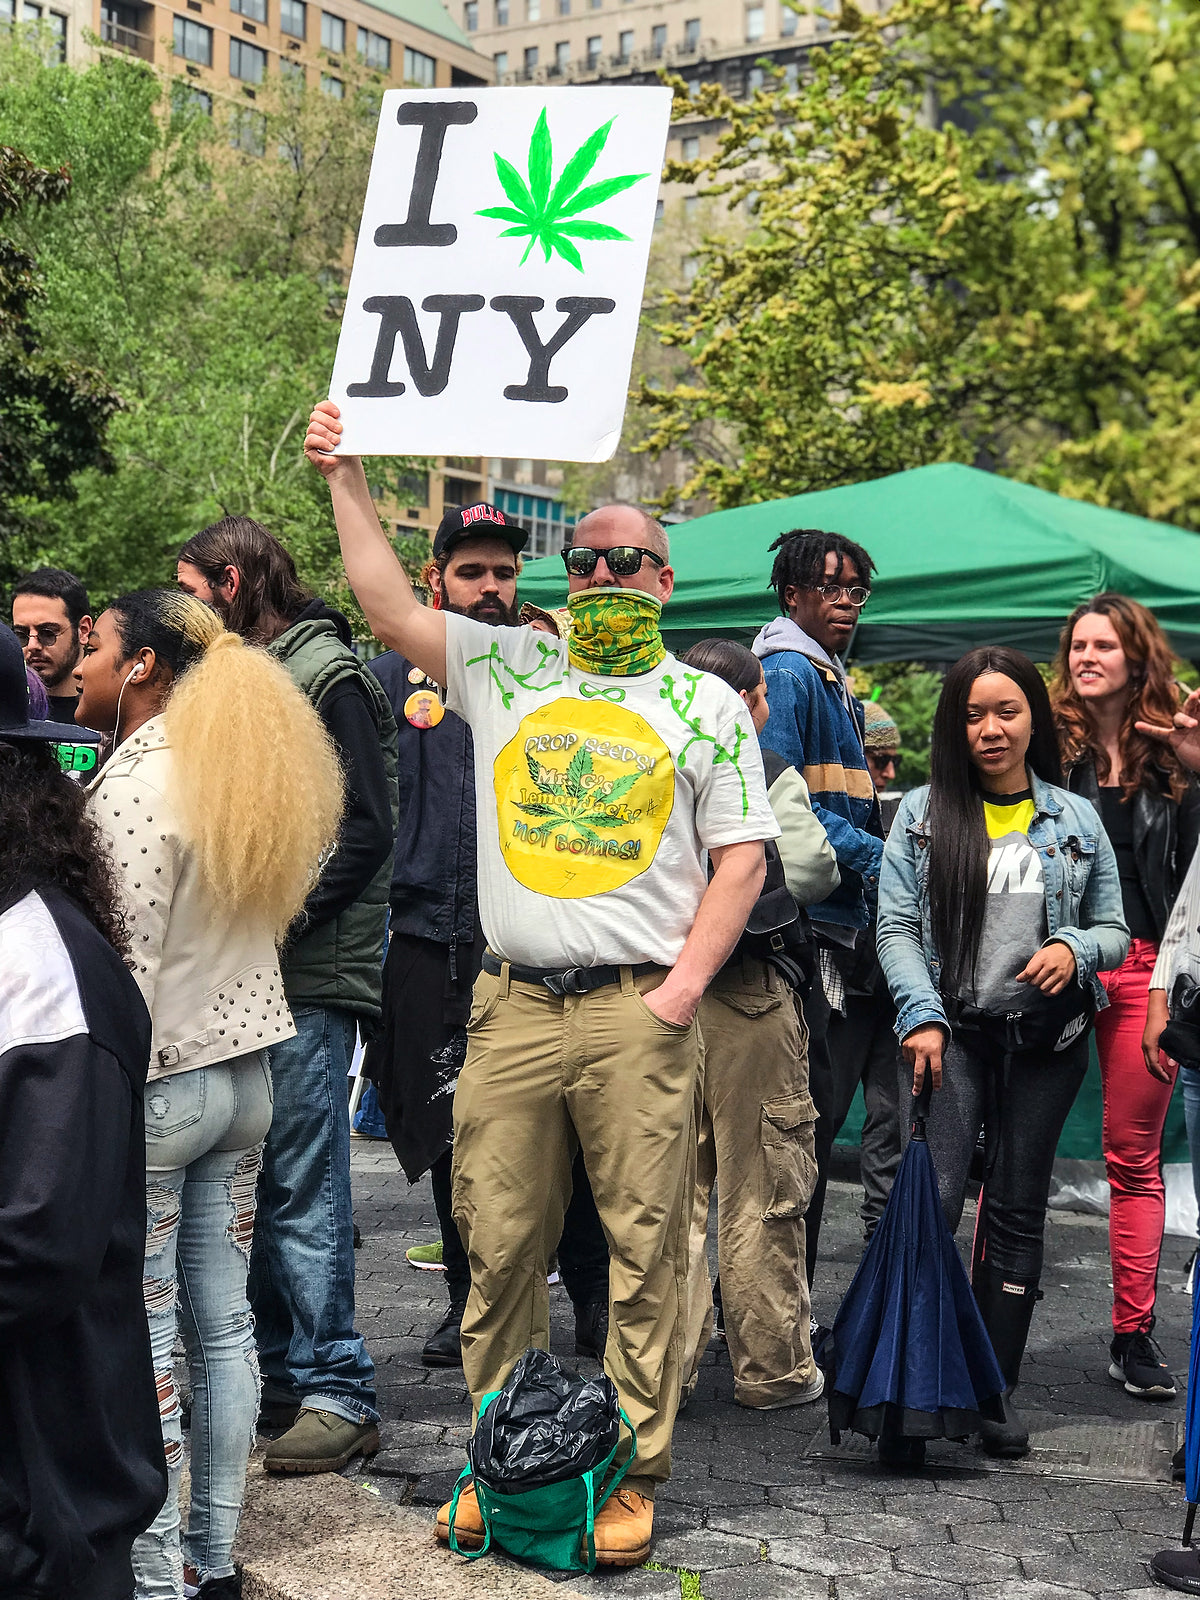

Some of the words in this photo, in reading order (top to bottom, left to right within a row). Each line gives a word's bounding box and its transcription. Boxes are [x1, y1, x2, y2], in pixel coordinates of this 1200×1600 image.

[374, 101, 478, 247] I
[346, 293, 616, 403] NY
[461, 504, 506, 527] BULLS
[50, 744, 96, 771] ED
[584, 738, 656, 775] SEEDS!
[537, 766, 572, 786] Mr.
[579, 772, 614, 795] G's
[520, 788, 578, 807] Lemon
[555, 833, 641, 861] BOMBS!
[1062, 1012, 1086, 1040] NIKE
